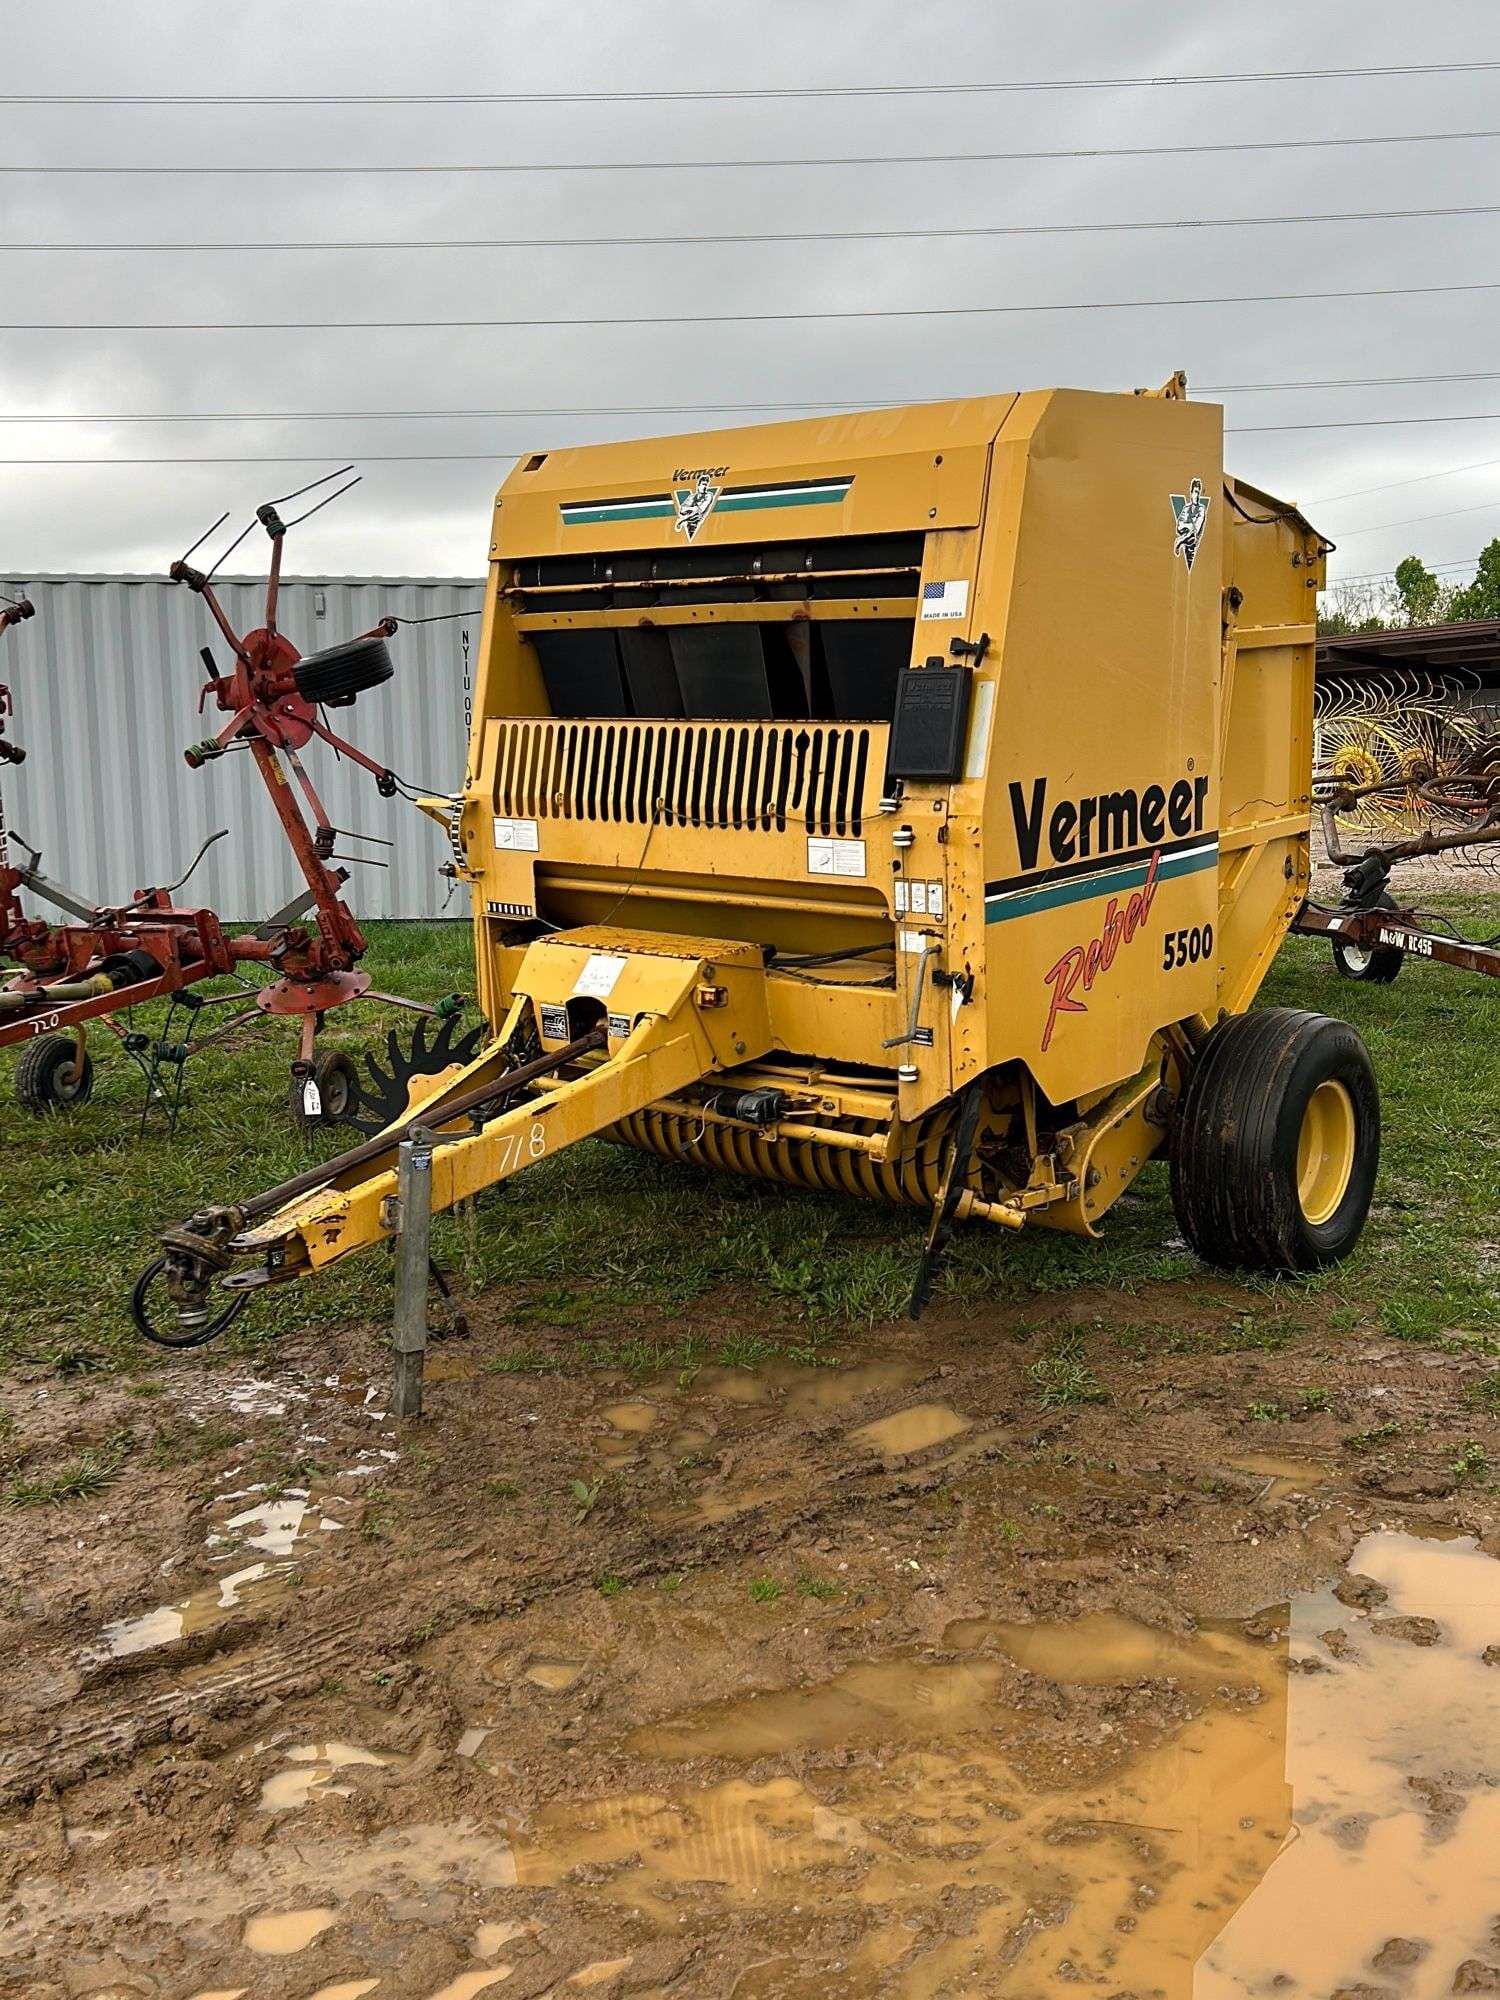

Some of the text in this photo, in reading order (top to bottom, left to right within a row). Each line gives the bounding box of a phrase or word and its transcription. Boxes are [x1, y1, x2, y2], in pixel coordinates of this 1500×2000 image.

[672, 465, 730, 482] Vermeer
[1008, 775, 1209, 871] Vermeer
[1040, 848, 1161, 1053] Rebel
[1162, 923, 1214, 971] 5500
[28, 1013, 59, 1034] 720
[494, 1122, 546, 1173] 718
